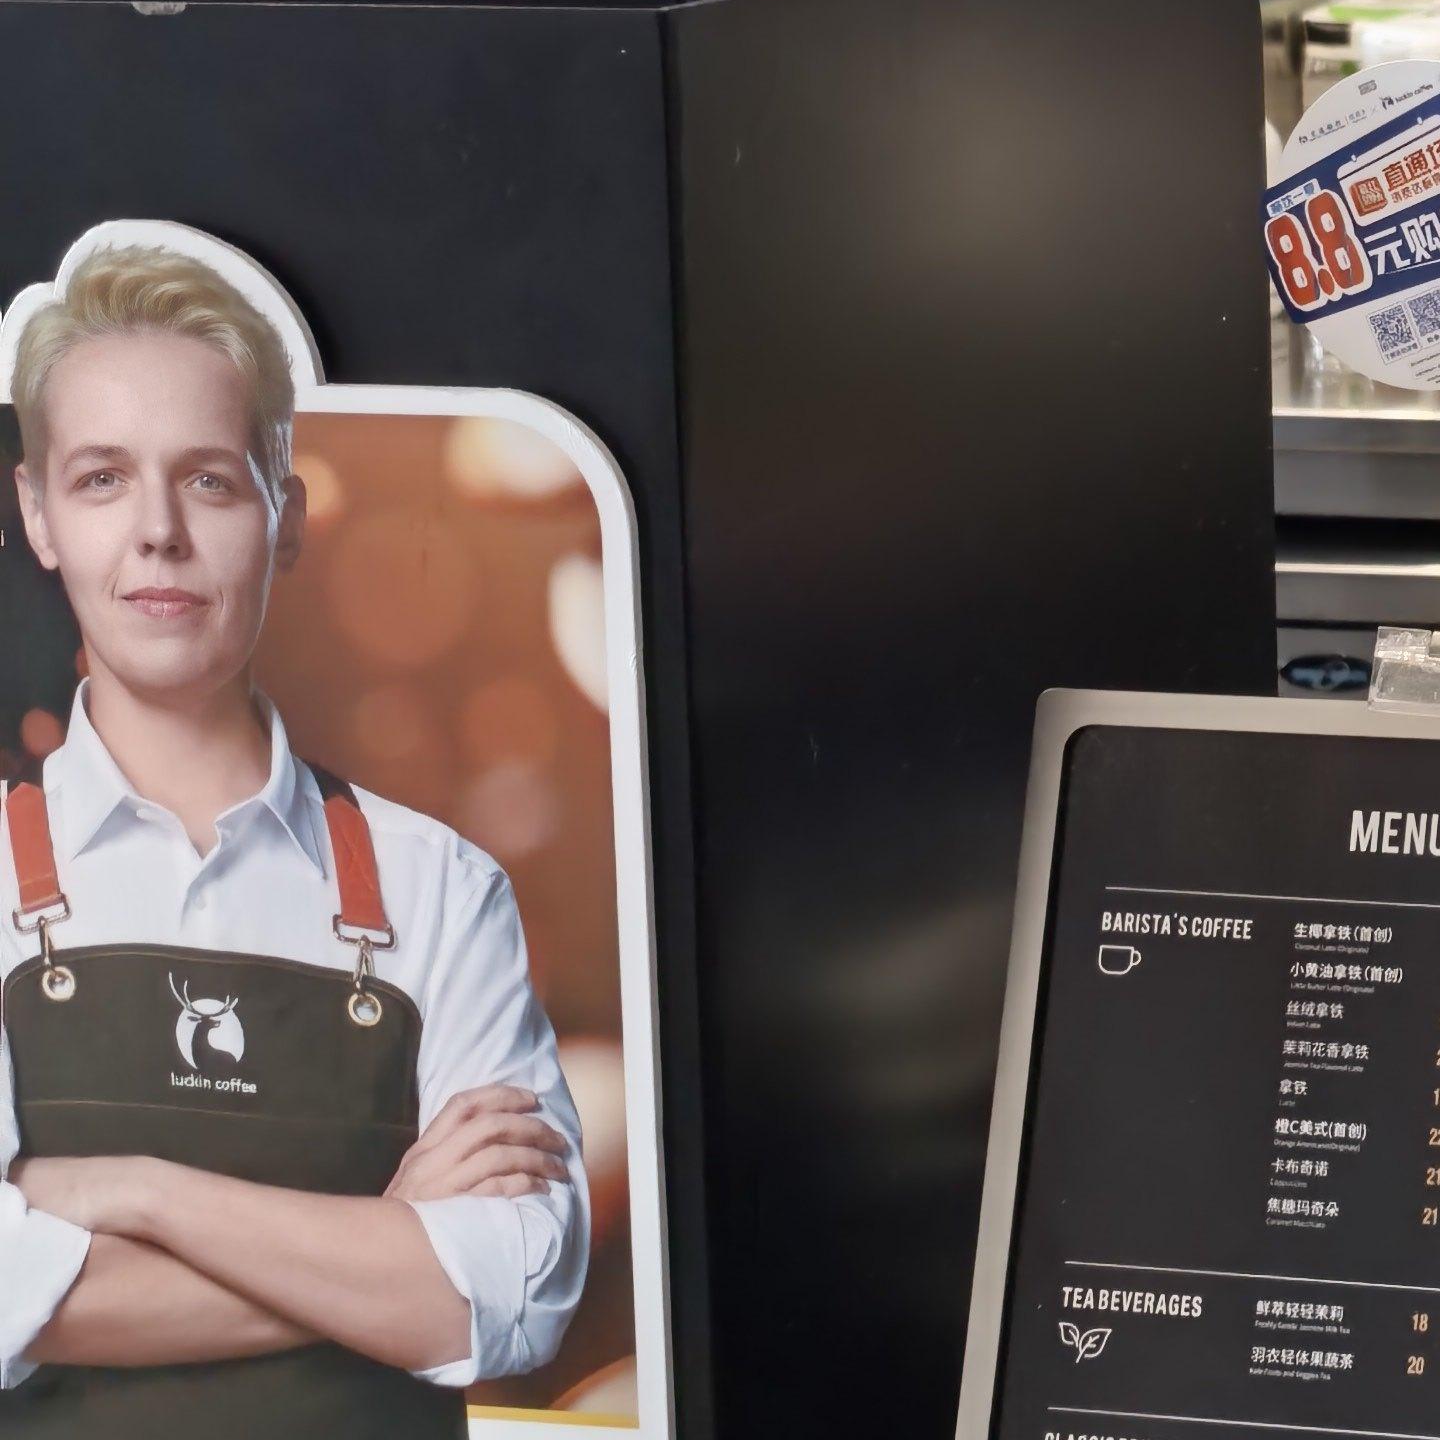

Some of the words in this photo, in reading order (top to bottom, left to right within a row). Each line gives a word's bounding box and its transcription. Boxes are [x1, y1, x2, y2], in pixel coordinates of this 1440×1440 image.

[1101, 910, 1189, 938] BARISTA'S
[1190, 916, 1254, 941] COFFEE
[1285, 1000, 1345, 1020] 丝绒拿铁
[170, 1071, 212, 1090] luckin
[214, 1077, 258, 1094] coffee
[1278, 1078, 1308, 1096] 拿铁
[1270, 1156, 1330, 1178] 卡布奇诺
[1421, 1206, 1439, 1227] 21
[1062, 1287, 1096, 1310] TEA
[1098, 1289, 1203, 1319] BEVERAGES
[1411, 1312, 1430, 1333] 18
[1406, 1355, 1426, 1376] 20
